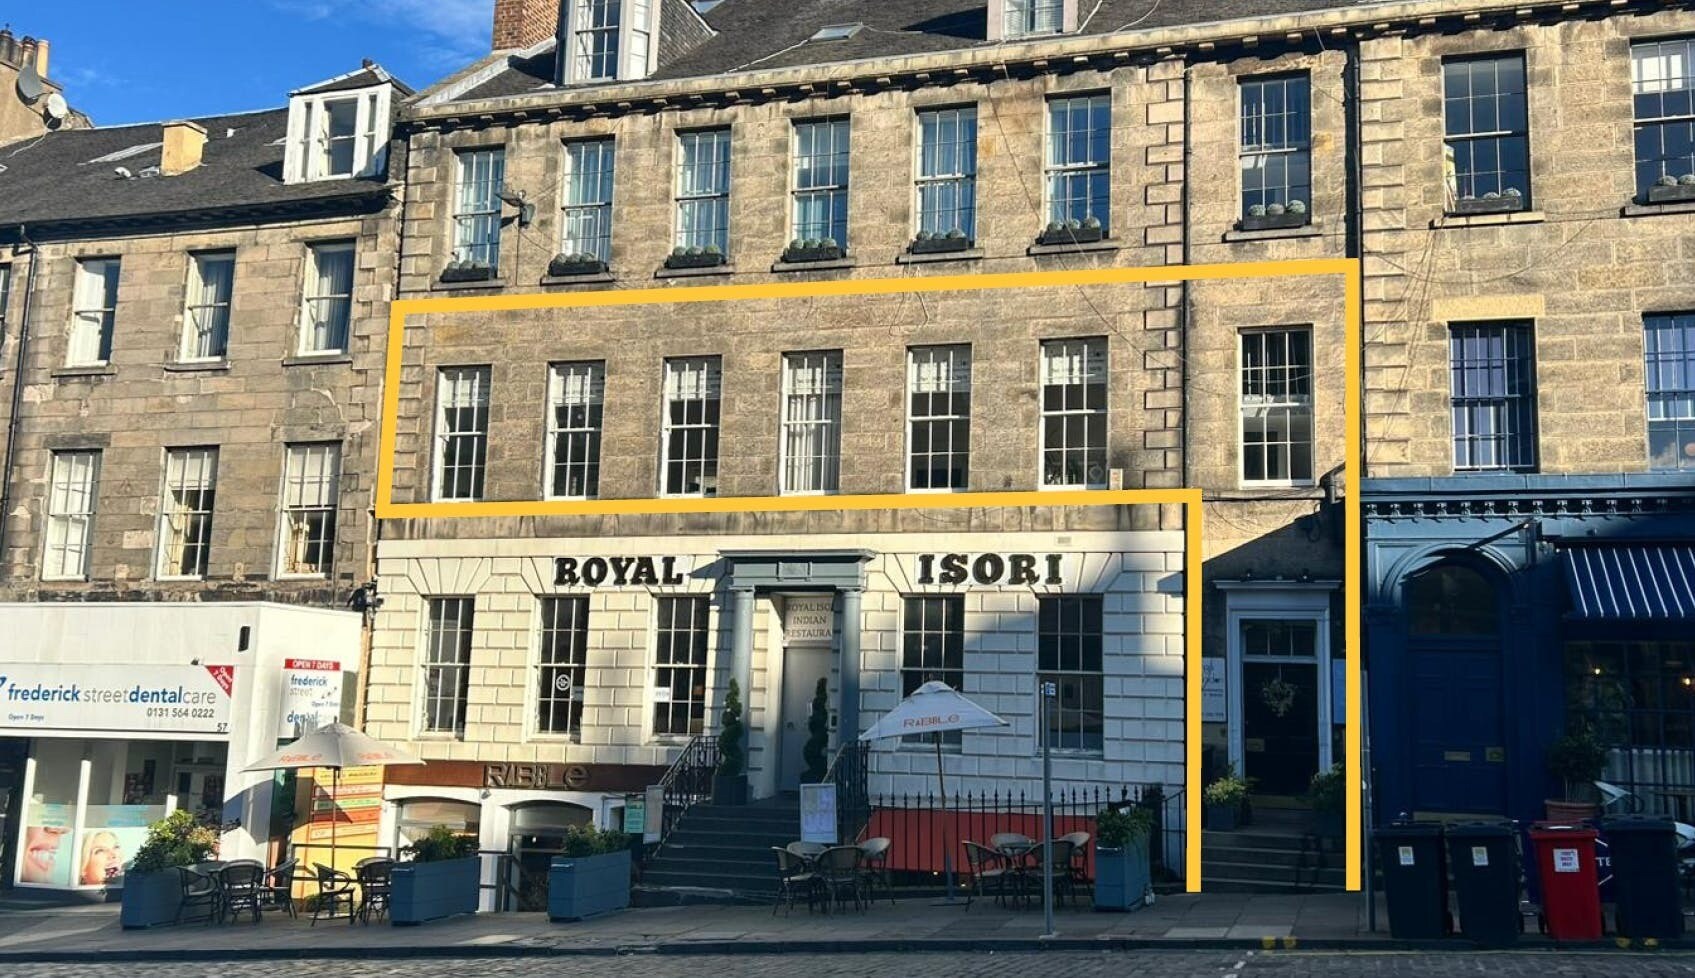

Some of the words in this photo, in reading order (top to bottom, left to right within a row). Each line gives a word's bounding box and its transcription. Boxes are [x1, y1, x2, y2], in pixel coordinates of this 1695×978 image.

[554, 556, 684, 588] ROYAL
[918, 553, 1063, 586] ISORI
[792, 615, 827, 625] INDIAN
[290, 674, 328, 687] frederick
[147, 707, 169, 717] 0131
[172, 708, 189, 718] 564
[191, 708, 215, 718] 0222
[217, 722, 228, 733] 57
[1595, 856, 1612, 867] TE
